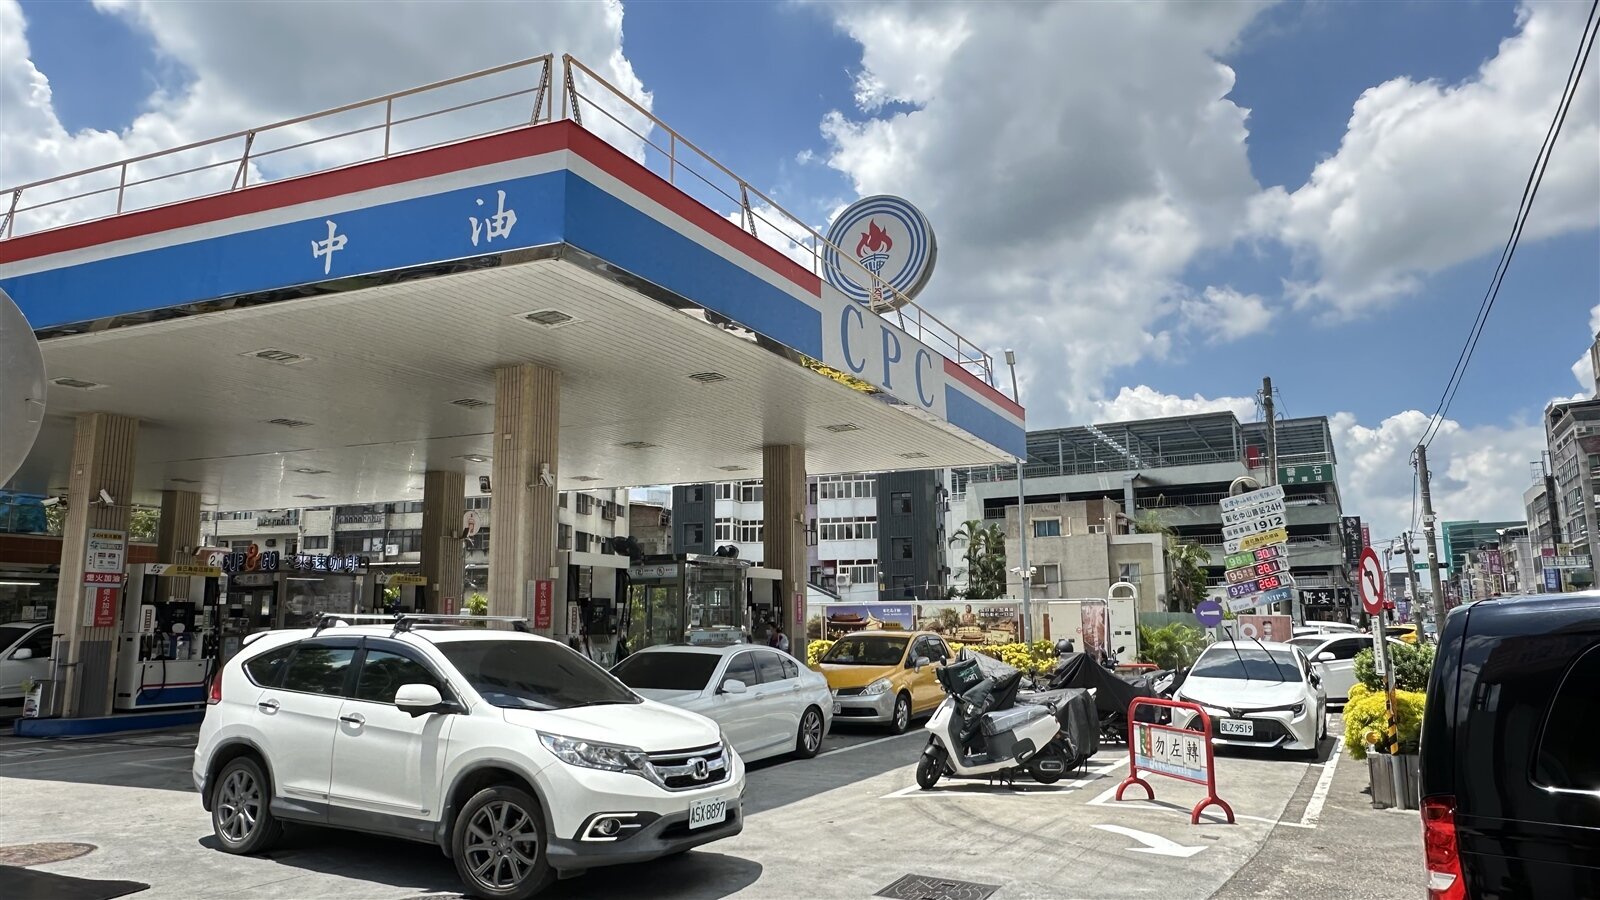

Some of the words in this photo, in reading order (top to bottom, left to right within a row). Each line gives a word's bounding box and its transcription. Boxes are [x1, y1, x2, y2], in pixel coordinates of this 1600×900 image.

[312, 190, 517, 275] 中油
[841, 303, 934, 408] CPC
[1253, 516, 1283, 531] 1912
[1228, 556, 1242, 567] 98
[1229, 570, 1244, 581] 95
[1230, 585, 1246, 596] 92
[1155, 736, 1199, 763] 勿左轉
